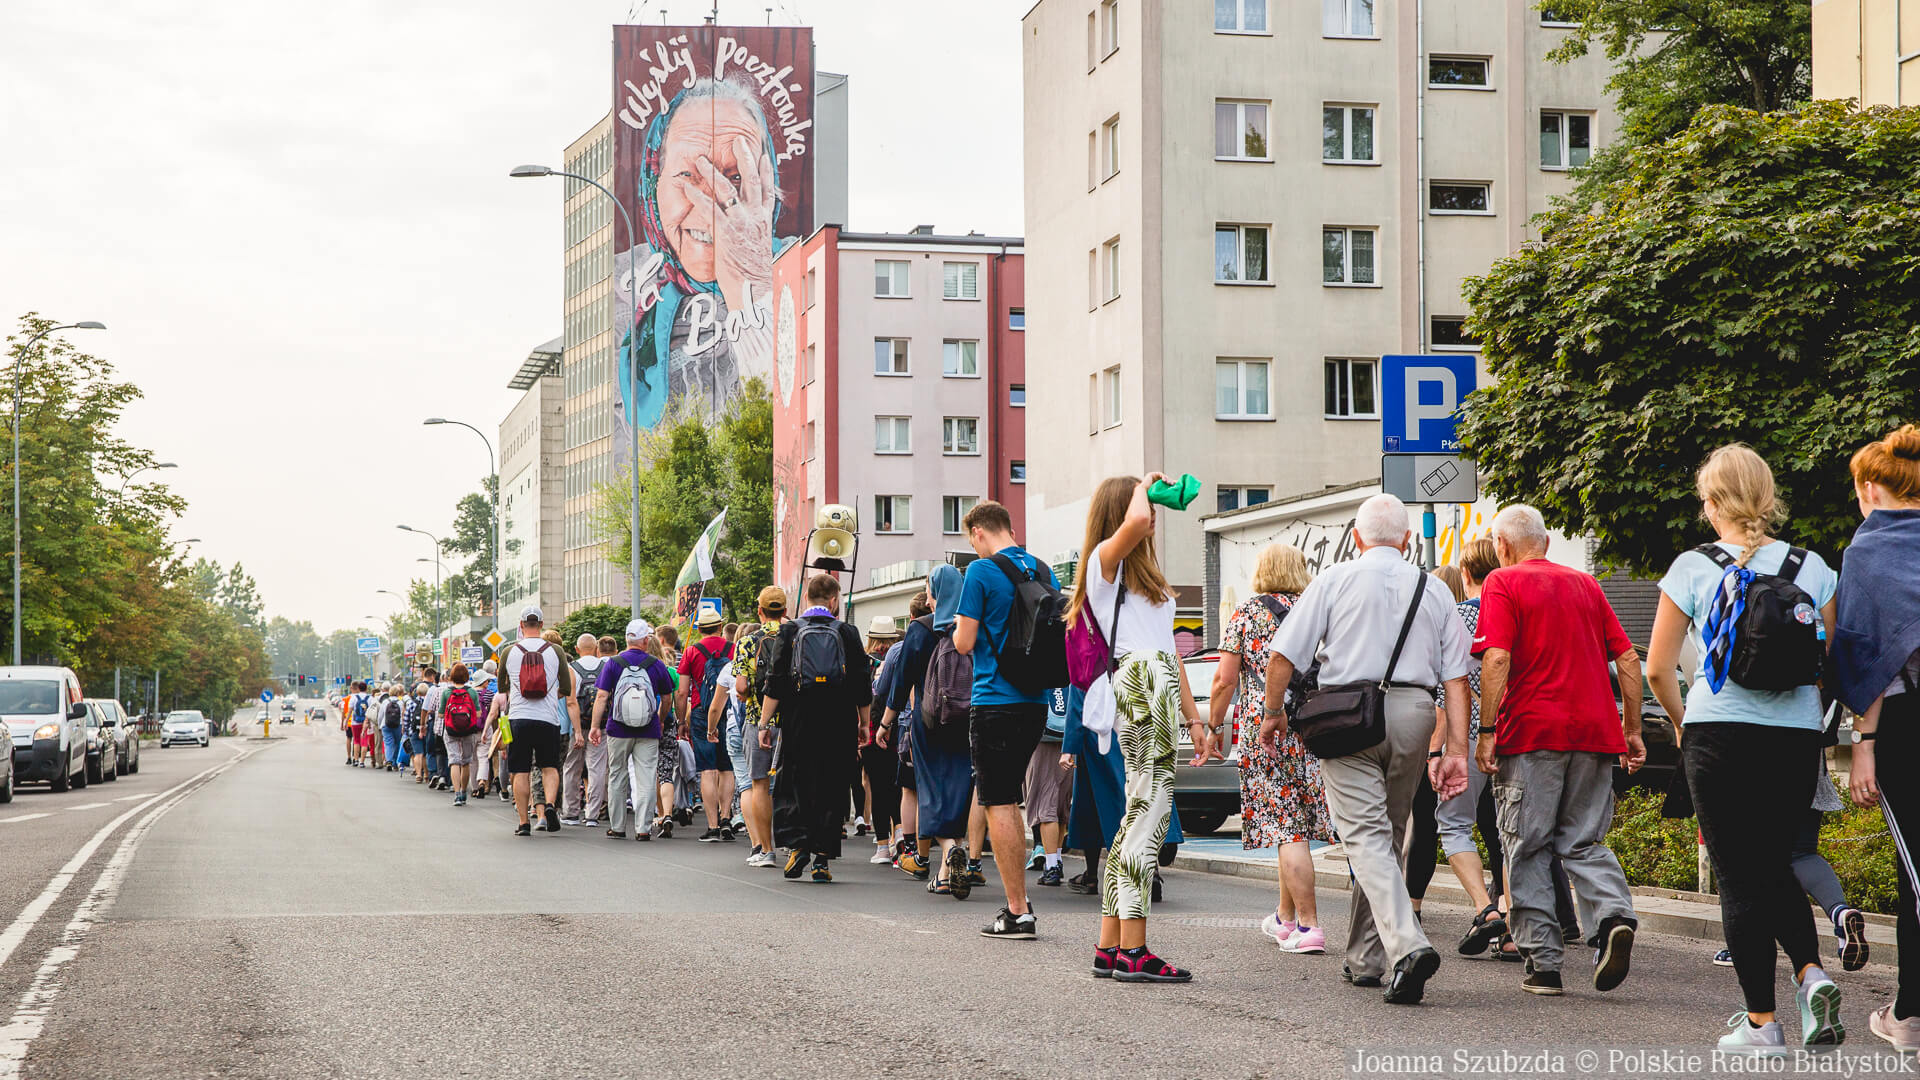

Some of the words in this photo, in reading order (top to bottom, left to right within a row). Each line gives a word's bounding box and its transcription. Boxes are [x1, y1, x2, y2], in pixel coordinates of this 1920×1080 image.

[682, 280, 766, 356] Bab
[1405, 366, 1457, 440] P
[1053, 687, 1065, 712] Reeb
